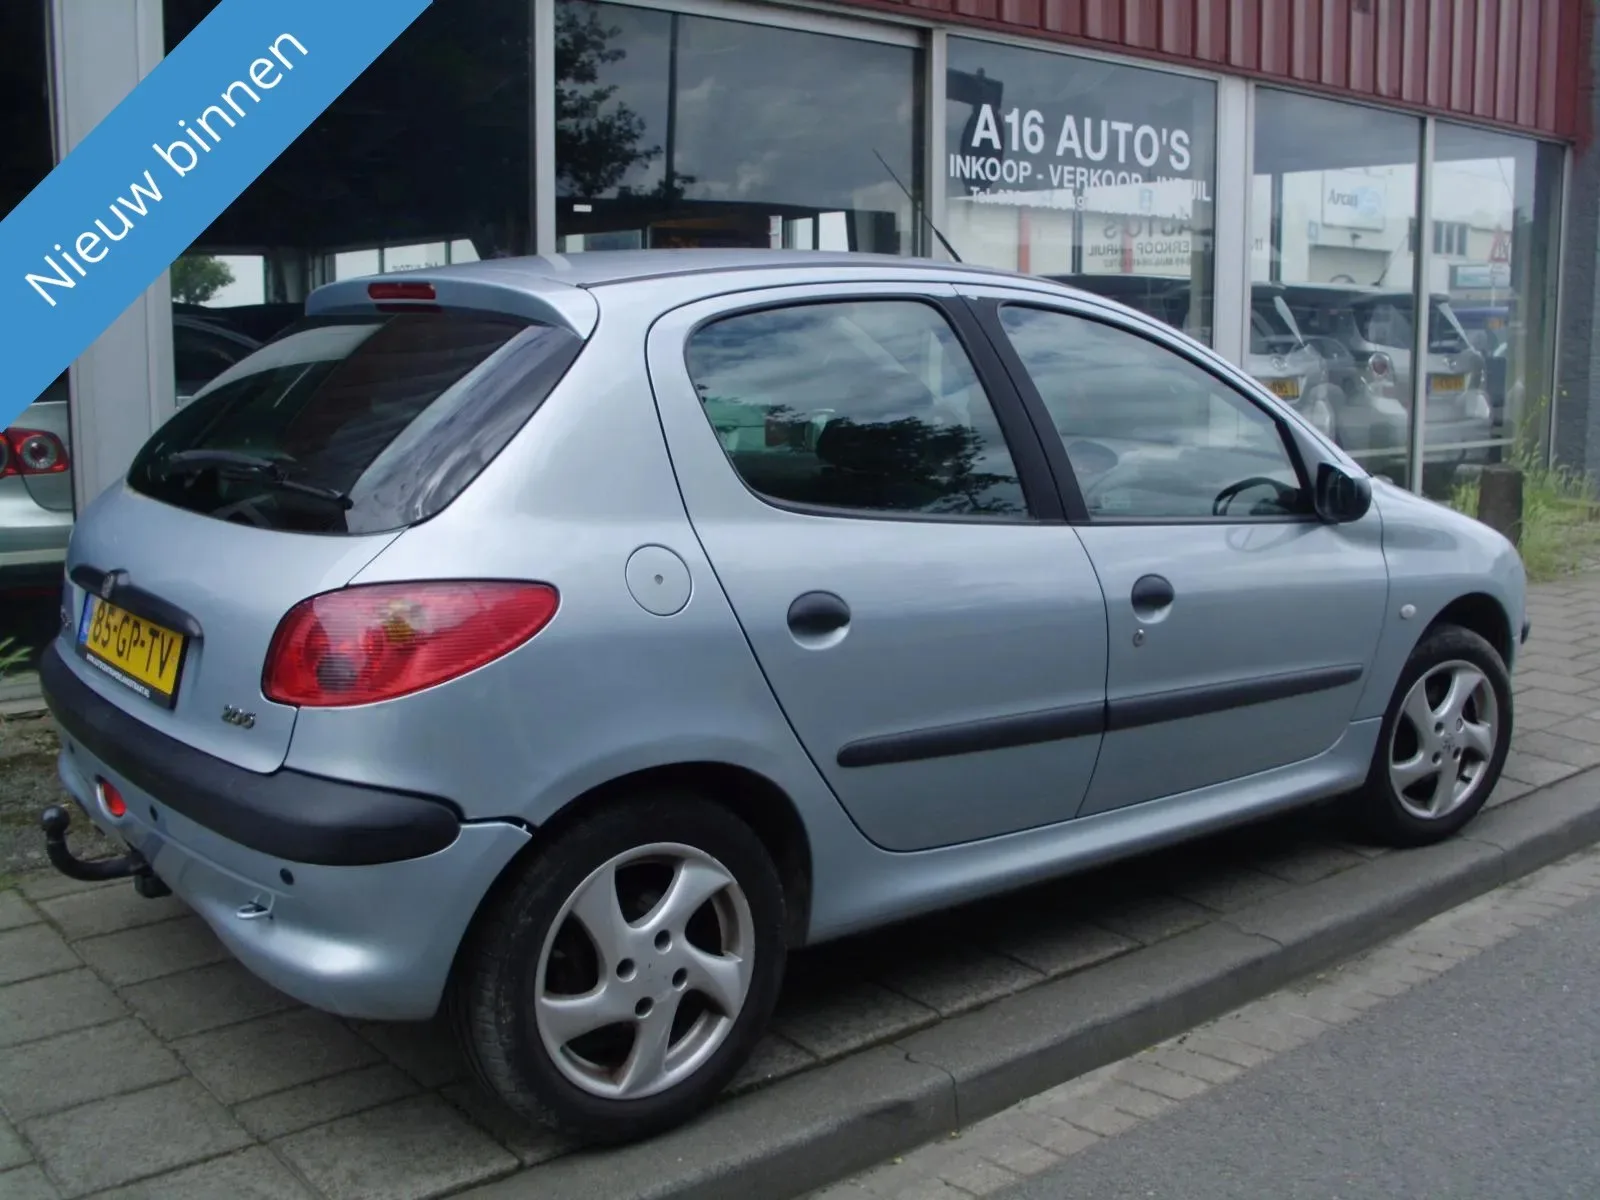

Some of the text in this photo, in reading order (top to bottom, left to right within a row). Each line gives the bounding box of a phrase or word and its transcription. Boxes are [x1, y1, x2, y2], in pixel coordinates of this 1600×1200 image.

[1056, 115, 1191, 171] AUTO'S
[950, 154, 1032, 184] INKOOP
[1049, 164, 1143, 189] VERKOOP
[92, 600, 174, 679] 85-GP-TV
